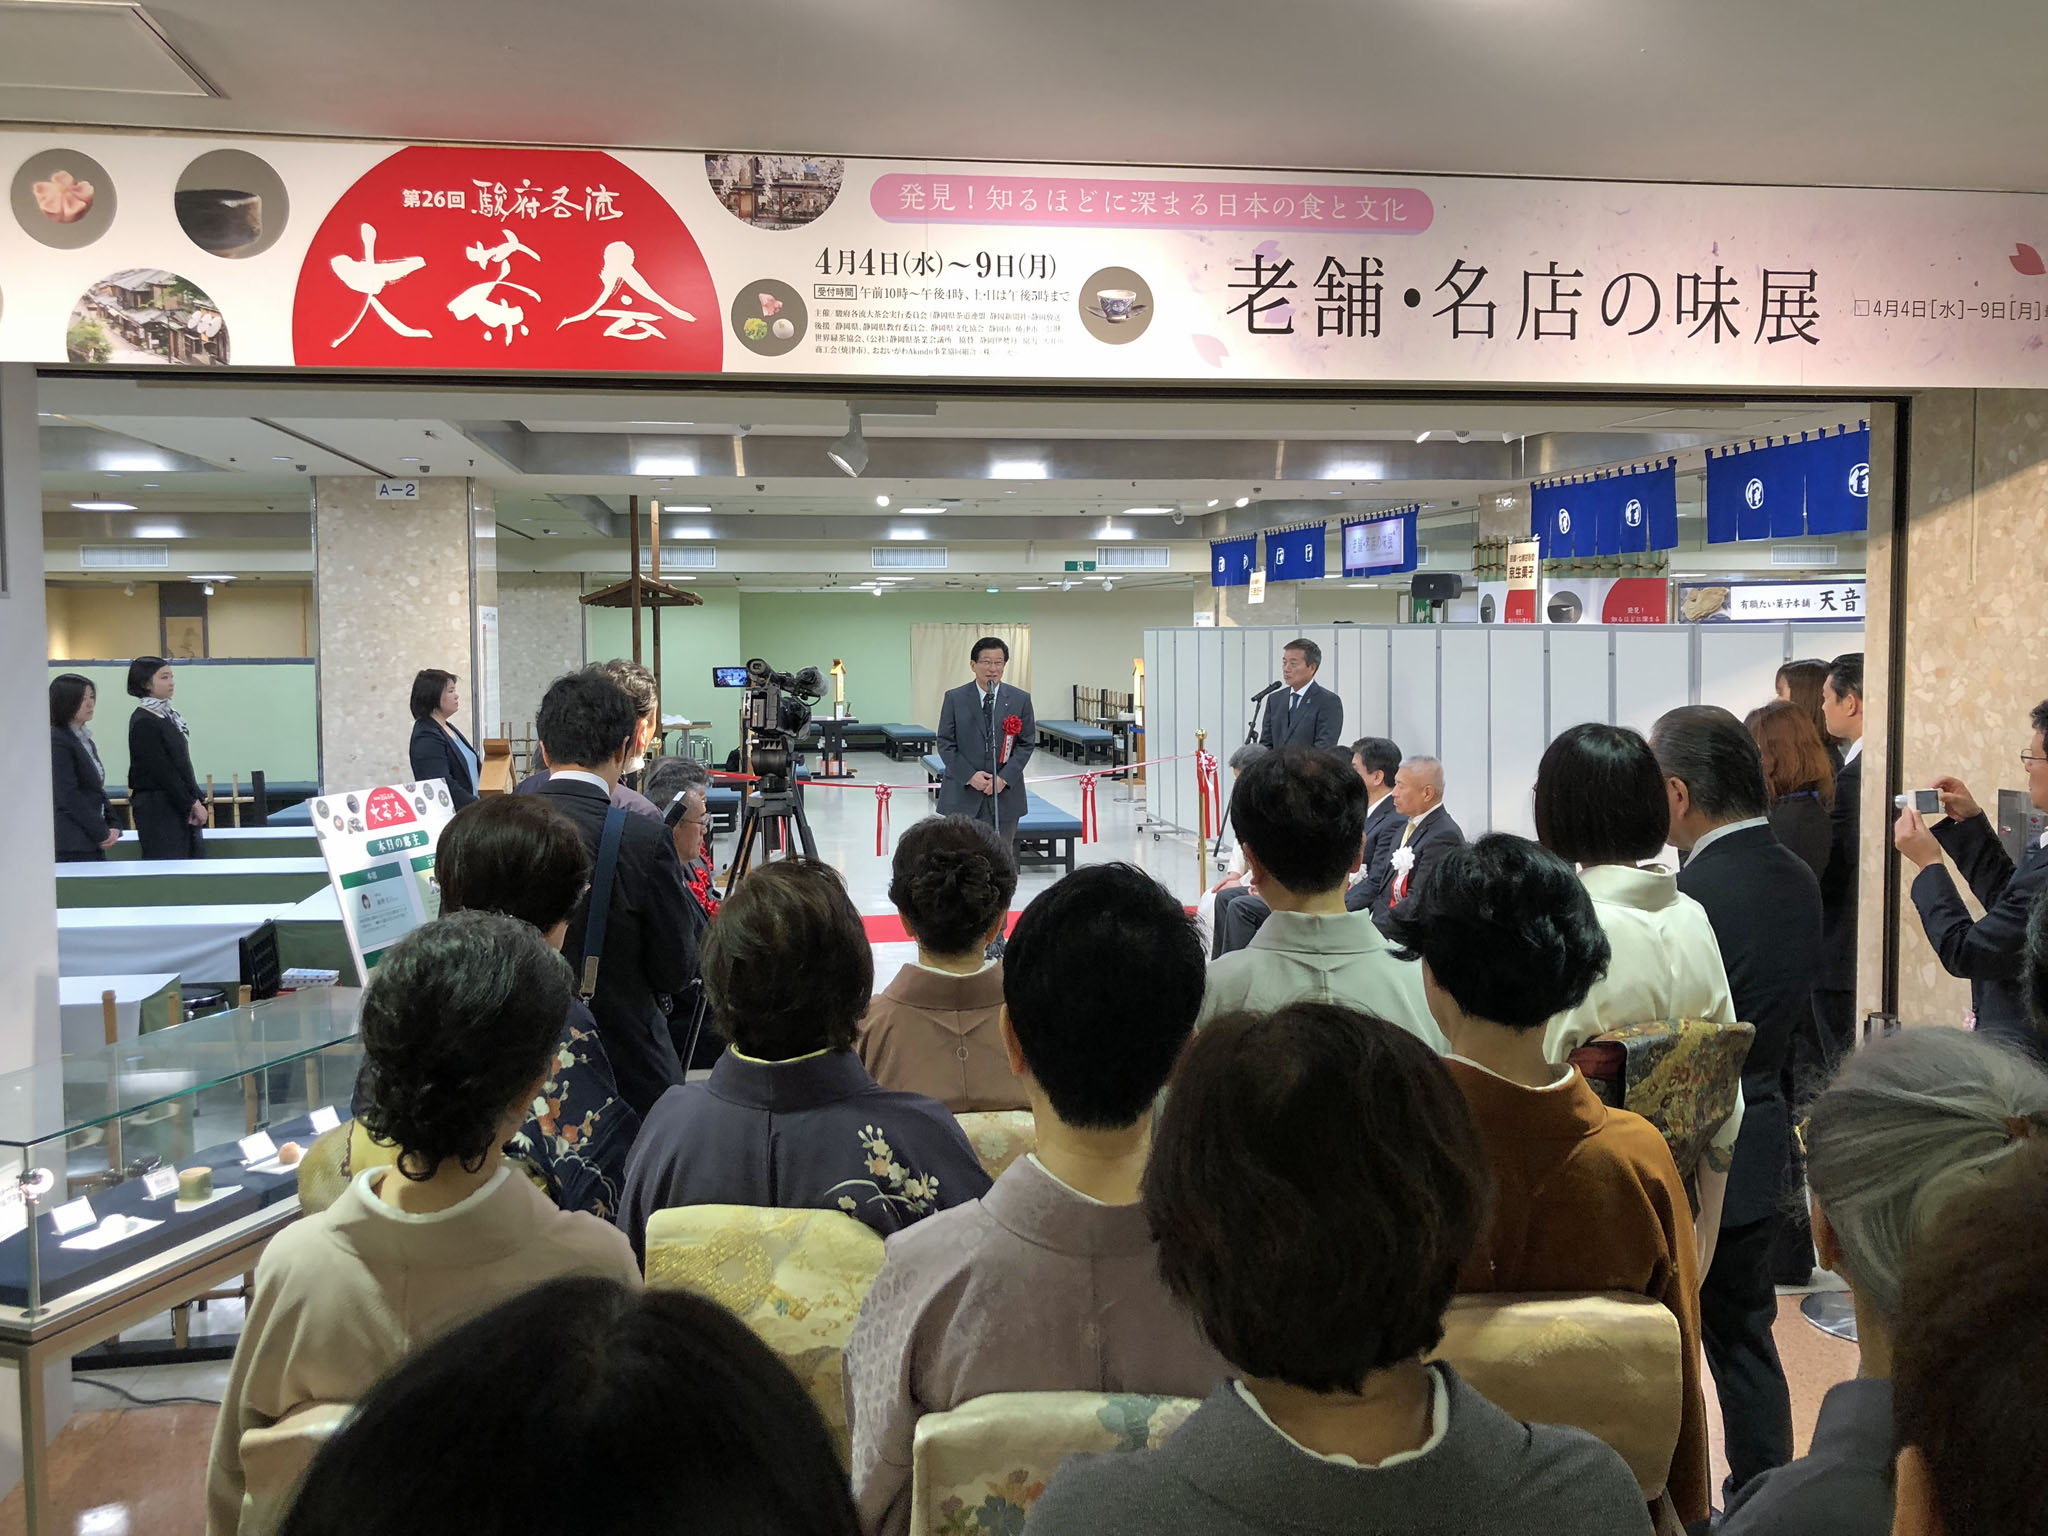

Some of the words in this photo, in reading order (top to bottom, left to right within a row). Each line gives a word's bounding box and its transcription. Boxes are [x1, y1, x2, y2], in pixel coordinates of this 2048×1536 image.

[402, 188, 466, 210] 第26回
[470, 178, 624, 222] 駿府各流
[899, 182, 1408, 223] 発見！知るほどに深まる日本の食と文化
[330, 222, 697, 348] 大茶会
[817, 286, 854, 298] 受付時間
[1226, 254, 1821, 346] 老舗・名店の味展
[379, 483, 416, 497] A-2
[1819, 587, 1861, 612] 天音
